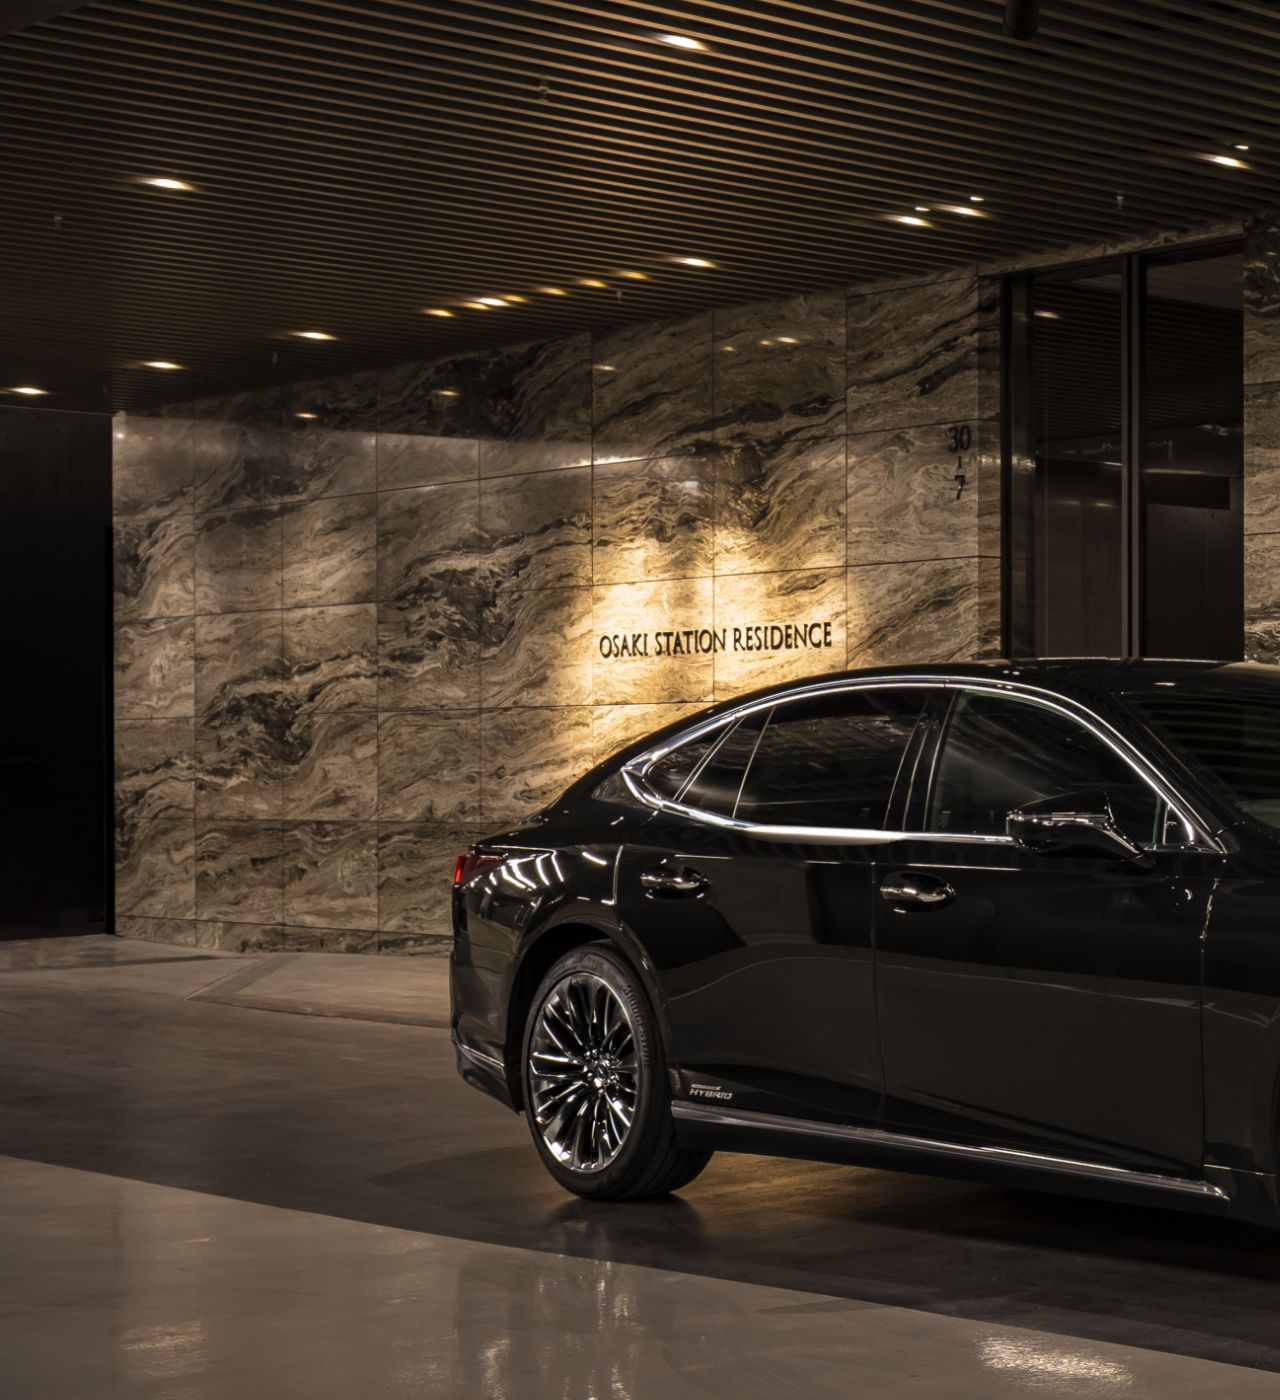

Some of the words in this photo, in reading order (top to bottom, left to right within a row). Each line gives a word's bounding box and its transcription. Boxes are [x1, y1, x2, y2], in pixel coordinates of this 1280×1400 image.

[948, 425, 971, 453] 30
[954, 474, 966, 500] 7
[600, 632, 648, 659] OSAKI
[655, 628, 726, 657] STATION
[733, 621, 832, 651] RESIDENCE
[689, 1088, 733, 1100] HYBRID
